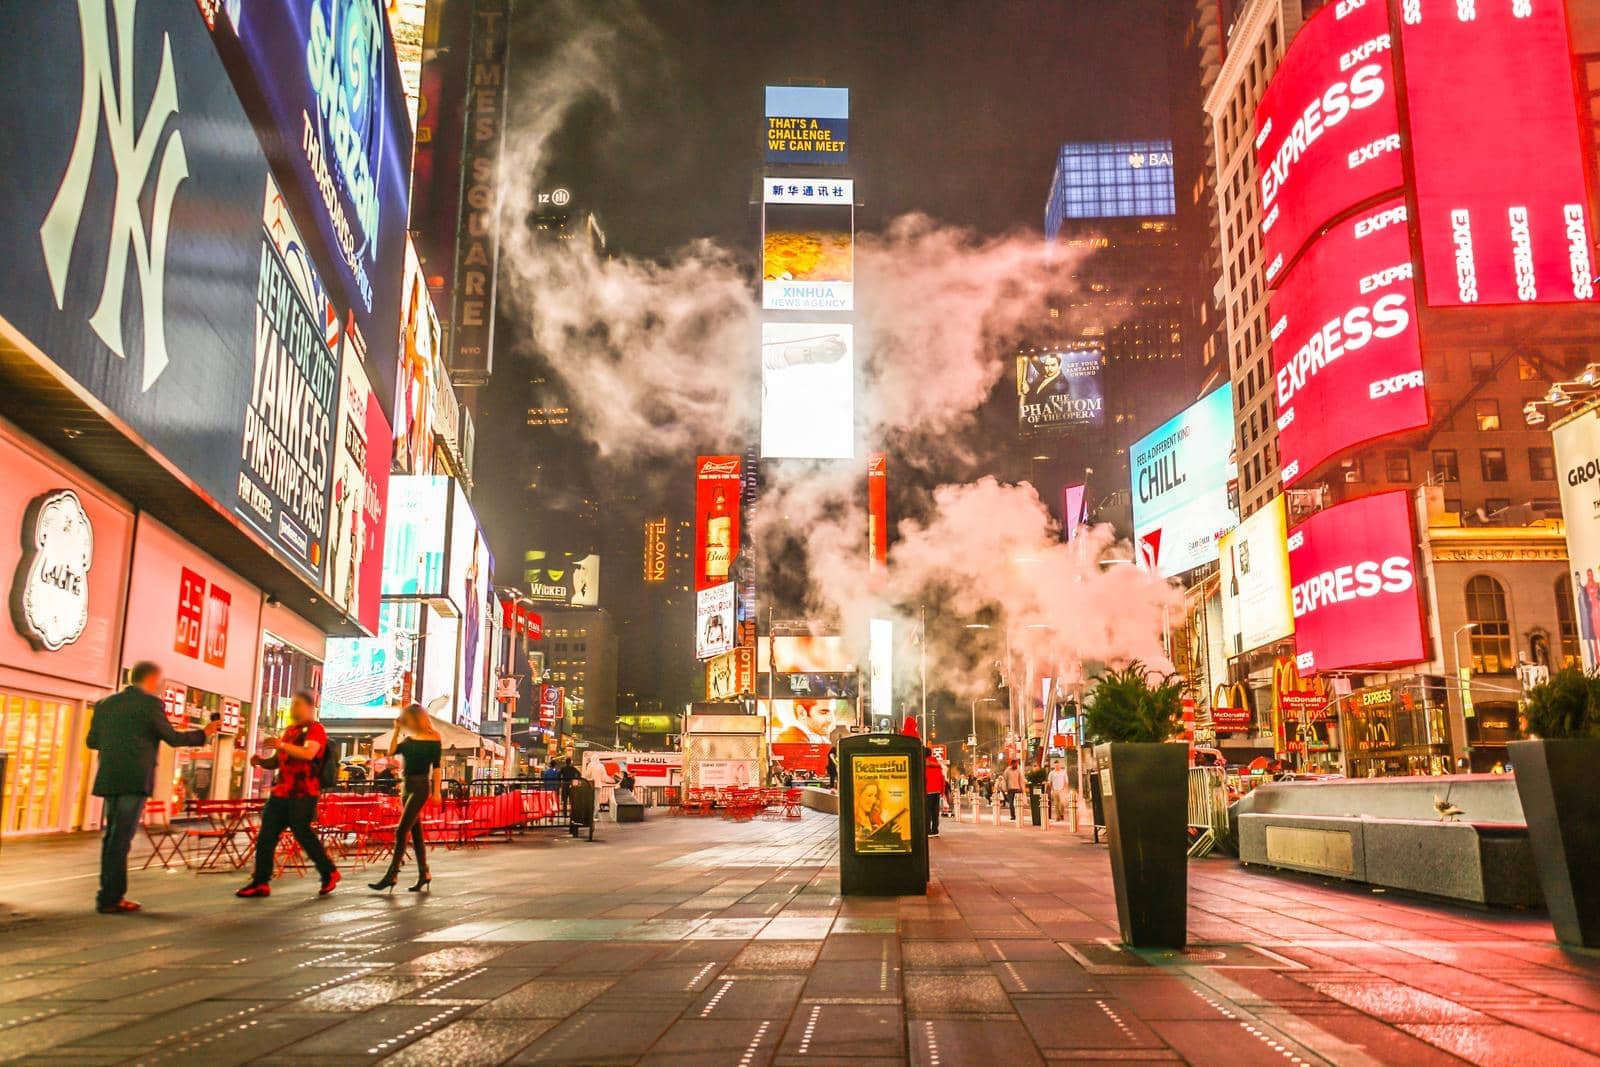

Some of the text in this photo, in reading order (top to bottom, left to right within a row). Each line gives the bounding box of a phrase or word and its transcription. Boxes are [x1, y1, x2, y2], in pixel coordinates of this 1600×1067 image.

[474, 12, 503, 140] TIMES
[768, 118, 818, 129] THAT'S A
[768, 129, 831, 141] CHALLENGE
[1261, 63, 1385, 211] EXPRESS
[768, 140, 846, 152] WE CAN MEET
[772, 184, 844, 198] 新华通讯社
[462, 157, 497, 327] SQUARE
[1563, 204, 1593, 299] EXPRESS
[1451, 209, 1478, 303] EXPRESS
[1508, 206, 1537, 301] EXPRESS
[771, 298, 846, 308] NEWS AGENCY
[783, 287, 835, 298] XINHUA
[257, 239, 335, 413] NEW FOR 2017
[461, 346, 481, 355] NYC
[1277, 294, 1409, 407] EXPRESS
[1369, 370, 1424, 400] EXPR
[251, 303, 330, 493] YANKEES
[1020, 397, 1103, 418] PHANTOM
[1049, 394, 1070, 402] THE
[1027, 410, 1095, 424] OF THE OPERA
[1136, 451, 1149, 468] FEEL
[1151, 438, 1178, 460] DIFFERENT
[242, 404, 323, 539] PINSTRIPE PASS
[1138, 450, 1187, 504] CHILL.
[1478, 549, 1515, 560] SHOW
[1291, 556, 1413, 619] EXPRESS
[1283, 696, 1327, 704] McDonald's
[1363, 688, 1392, 706] EXPRESS
[633, 757, 668, 765] U-HAUL
[855, 760, 907, 773] Beautiful
